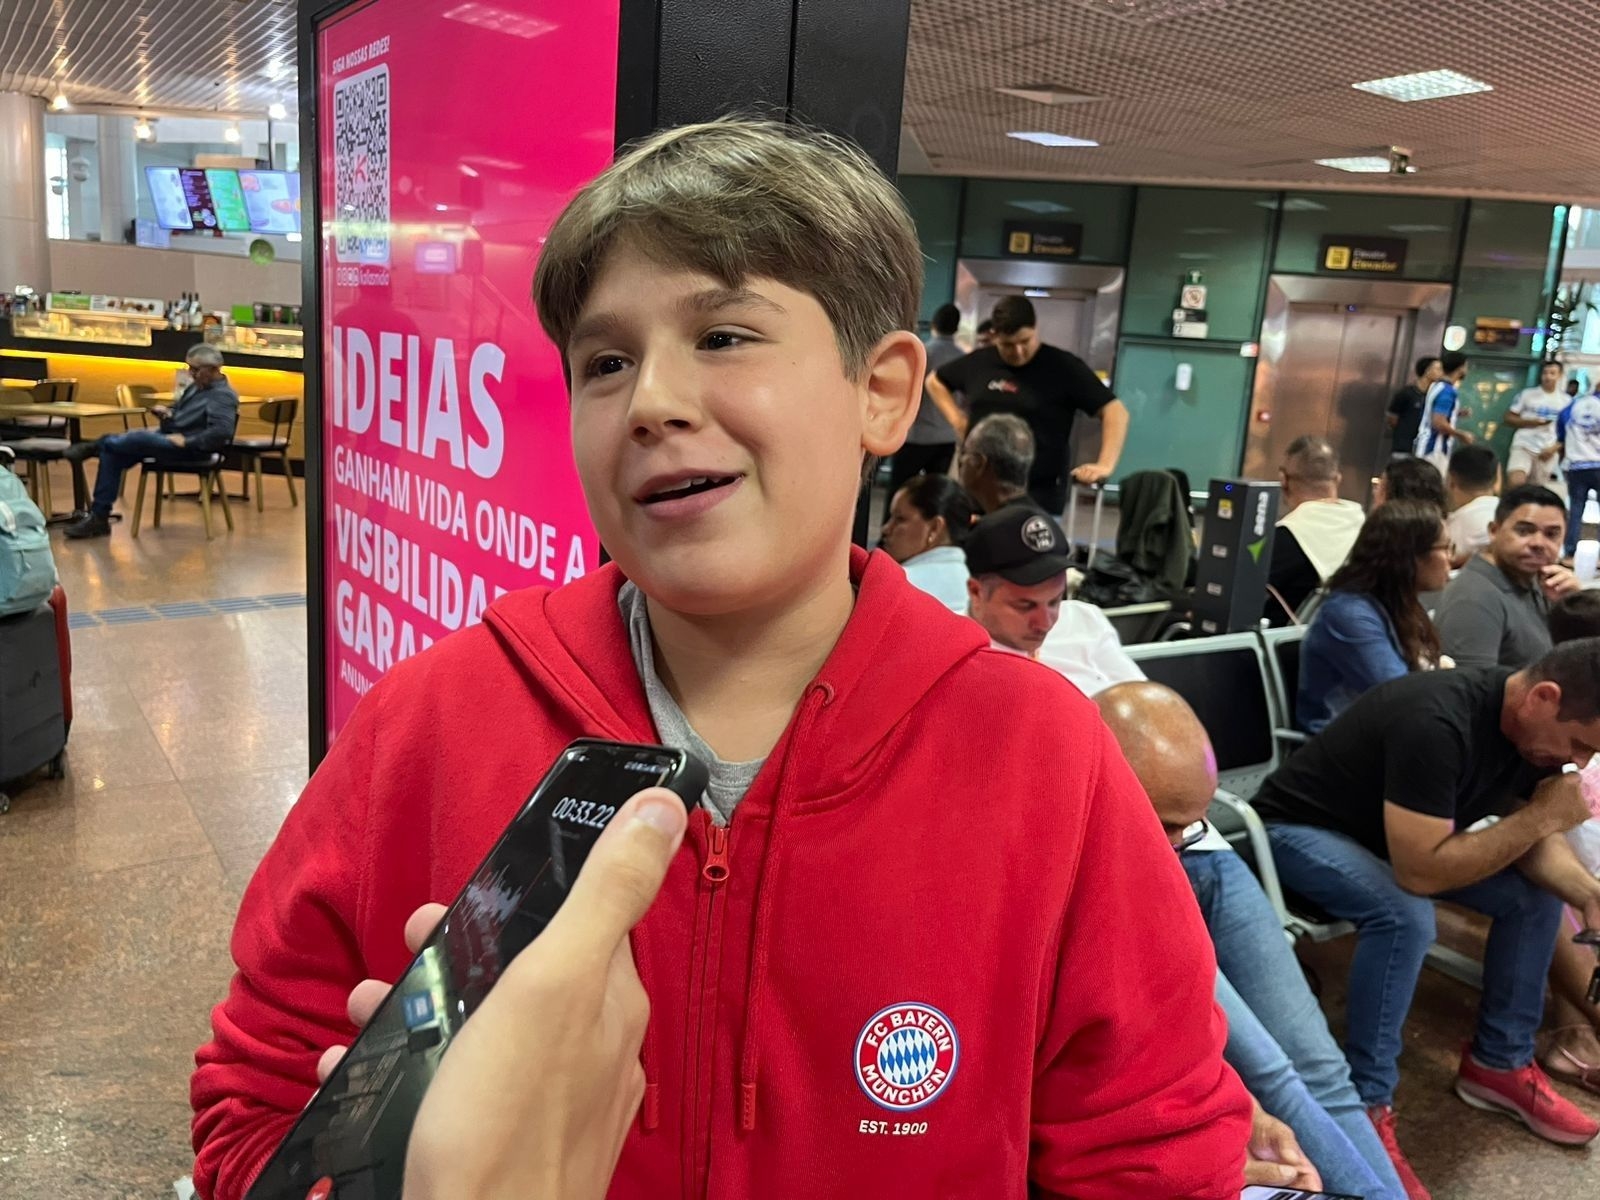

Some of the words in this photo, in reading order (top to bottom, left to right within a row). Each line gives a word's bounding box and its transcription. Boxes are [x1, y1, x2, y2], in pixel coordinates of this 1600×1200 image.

[333, 325, 506, 479] IDEIAS
[335, 444, 410, 514] GANHAM
[415, 474, 469, 542] VIDA
[475, 499, 556, 580] ONDE
[563, 534, 586, 584] A
[335, 503, 509, 631] VISIBILIDA
[336, 579, 434, 673] GARA
[341, 658, 374, 696] ANUN
[551, 796, 616, 829] 00:33.22
[866, 1022, 889, 1048] FC
[889, 1010, 952, 1052] BAYERN
[859, 1119, 888, 1135] EST.
[892, 1121, 928, 1135] 1900
